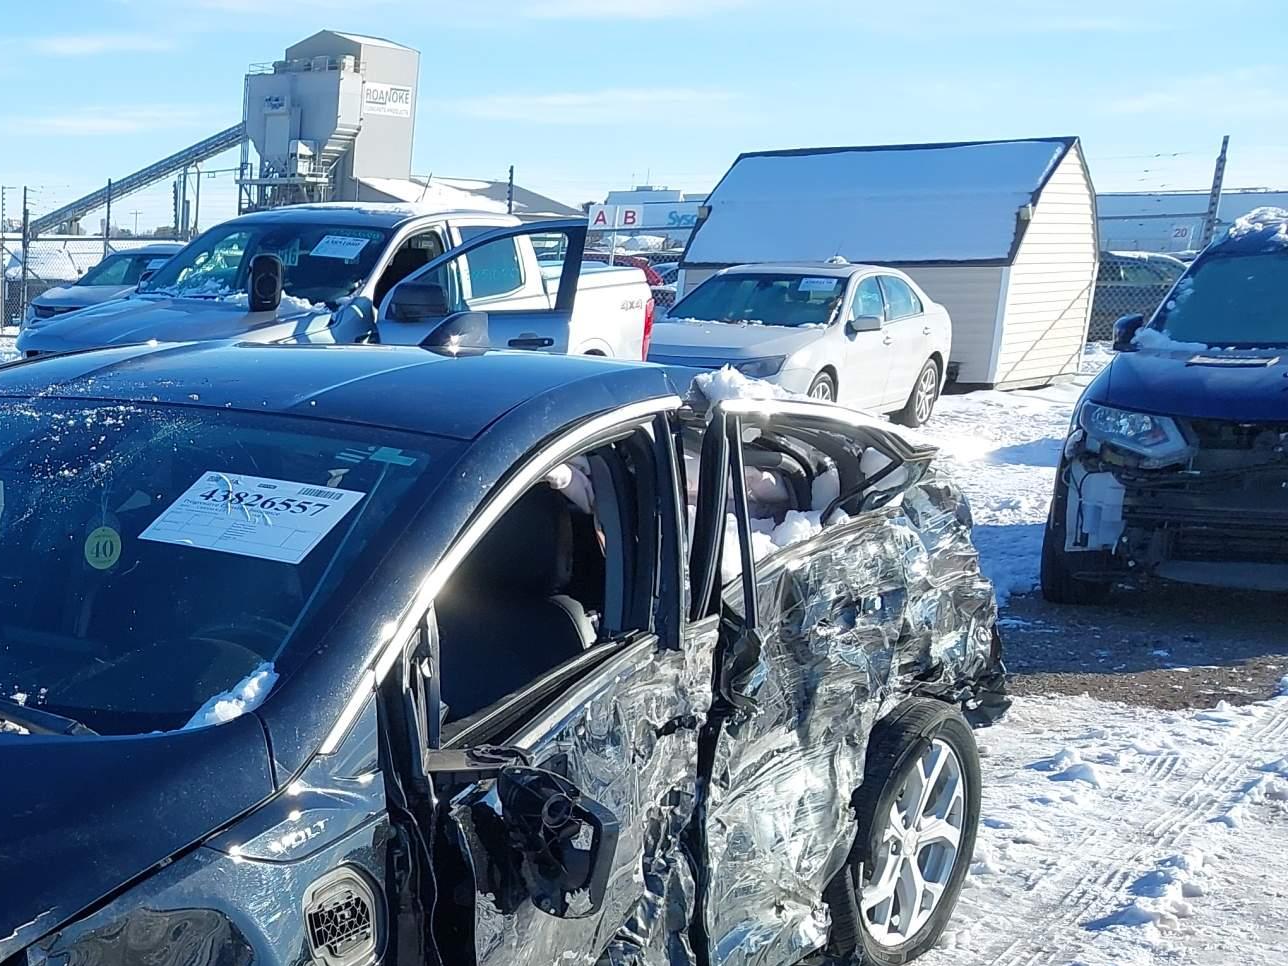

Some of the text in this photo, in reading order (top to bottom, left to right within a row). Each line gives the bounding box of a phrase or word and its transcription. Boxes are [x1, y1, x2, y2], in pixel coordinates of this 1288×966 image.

[366, 88, 410, 105] ROANOKE
[594, 210, 608, 225] A
[623, 210, 637, 225] B
[1174, 228, 1187, 238] 20
[199, 488, 330, 518] 43826557
[281, 818, 329, 852] VOLT
